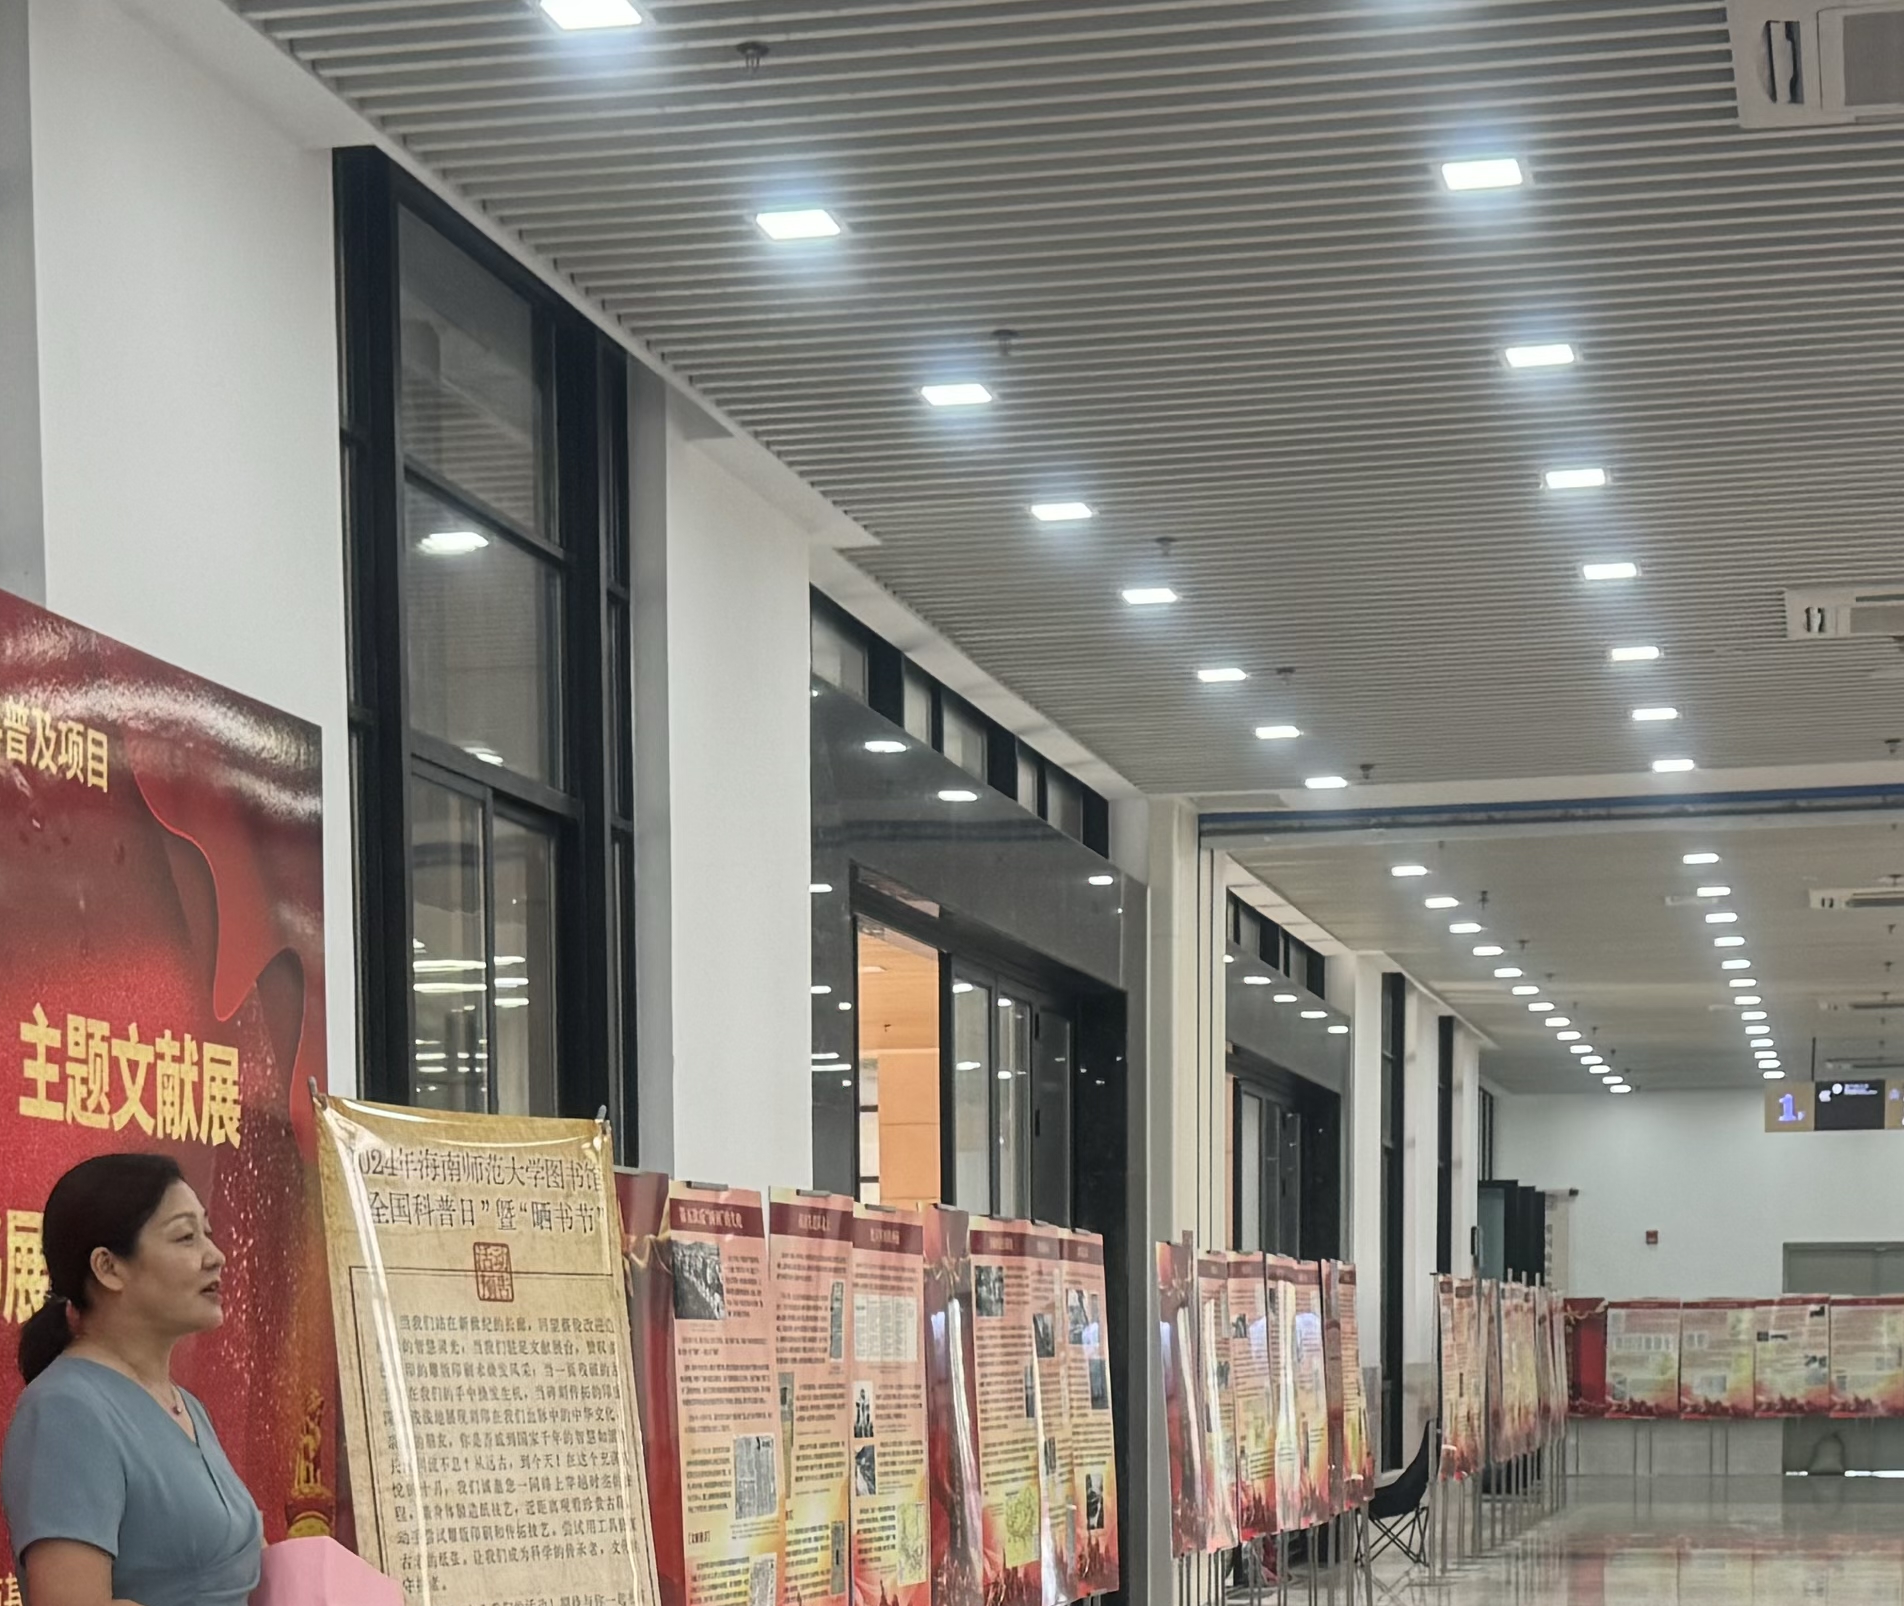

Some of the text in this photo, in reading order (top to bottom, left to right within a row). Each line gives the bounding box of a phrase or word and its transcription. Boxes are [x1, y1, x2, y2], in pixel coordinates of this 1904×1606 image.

[18, 1003, 244, 1149] 主题文献展
[354, 1147, 604, 1193] 024年海南师范大学图书馆
